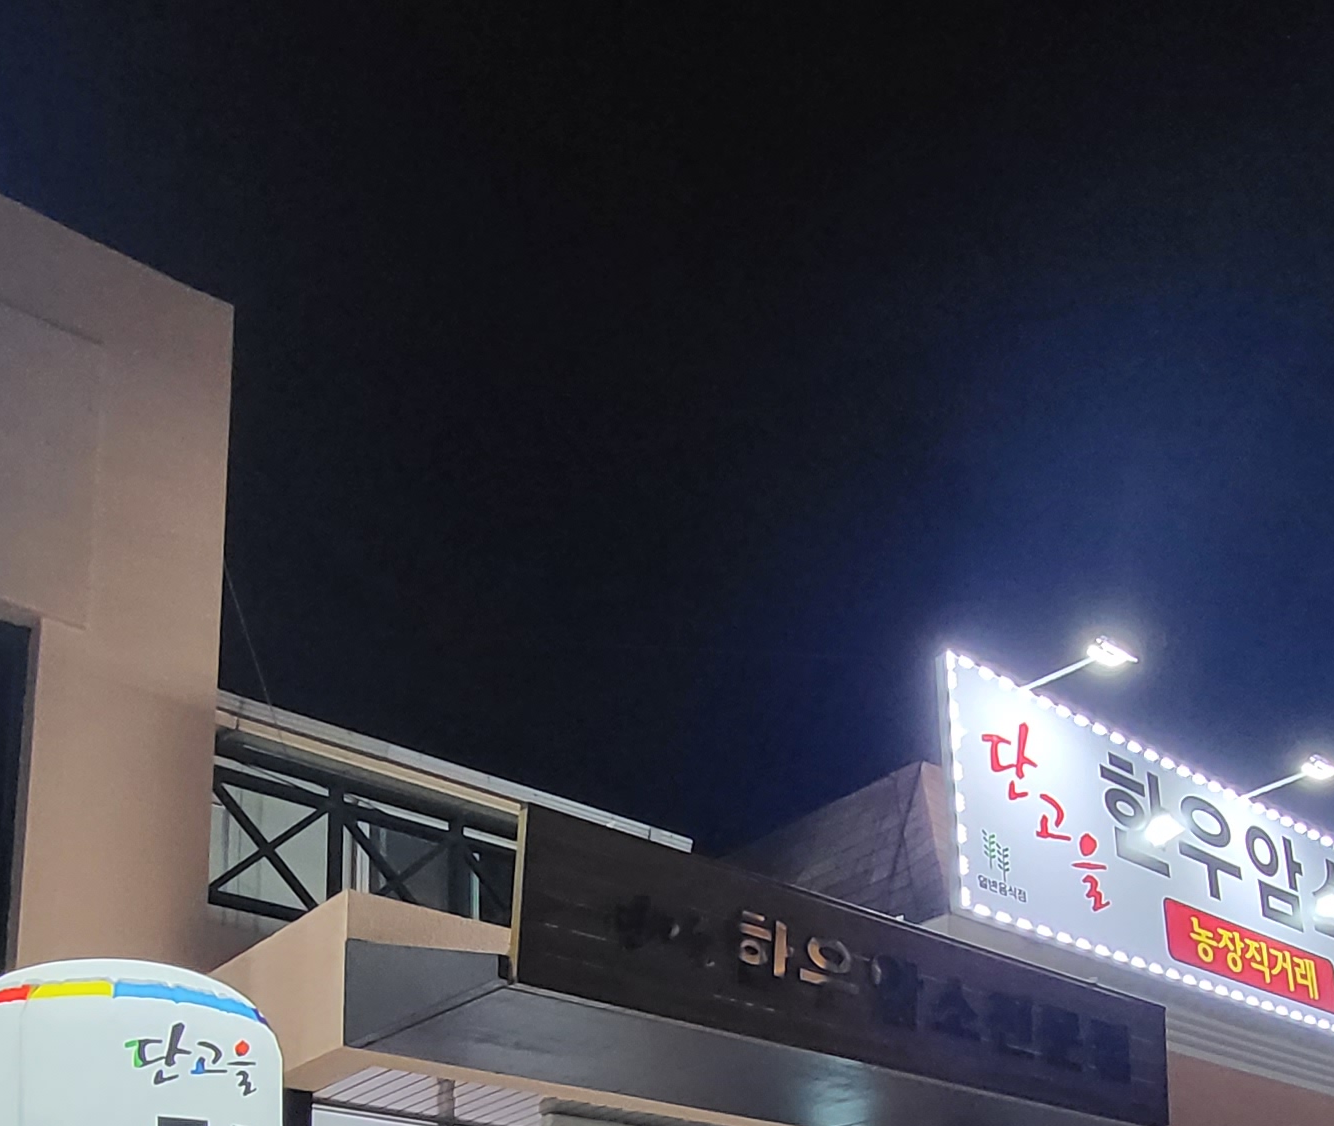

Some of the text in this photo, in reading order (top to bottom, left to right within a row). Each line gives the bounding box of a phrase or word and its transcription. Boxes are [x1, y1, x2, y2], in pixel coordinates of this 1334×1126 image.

[981, 722, 1110, 911] 단고을
[1189, 915, 1320, 1001] 농장직거래
[124, 1022, 257, 1096] 단고을
